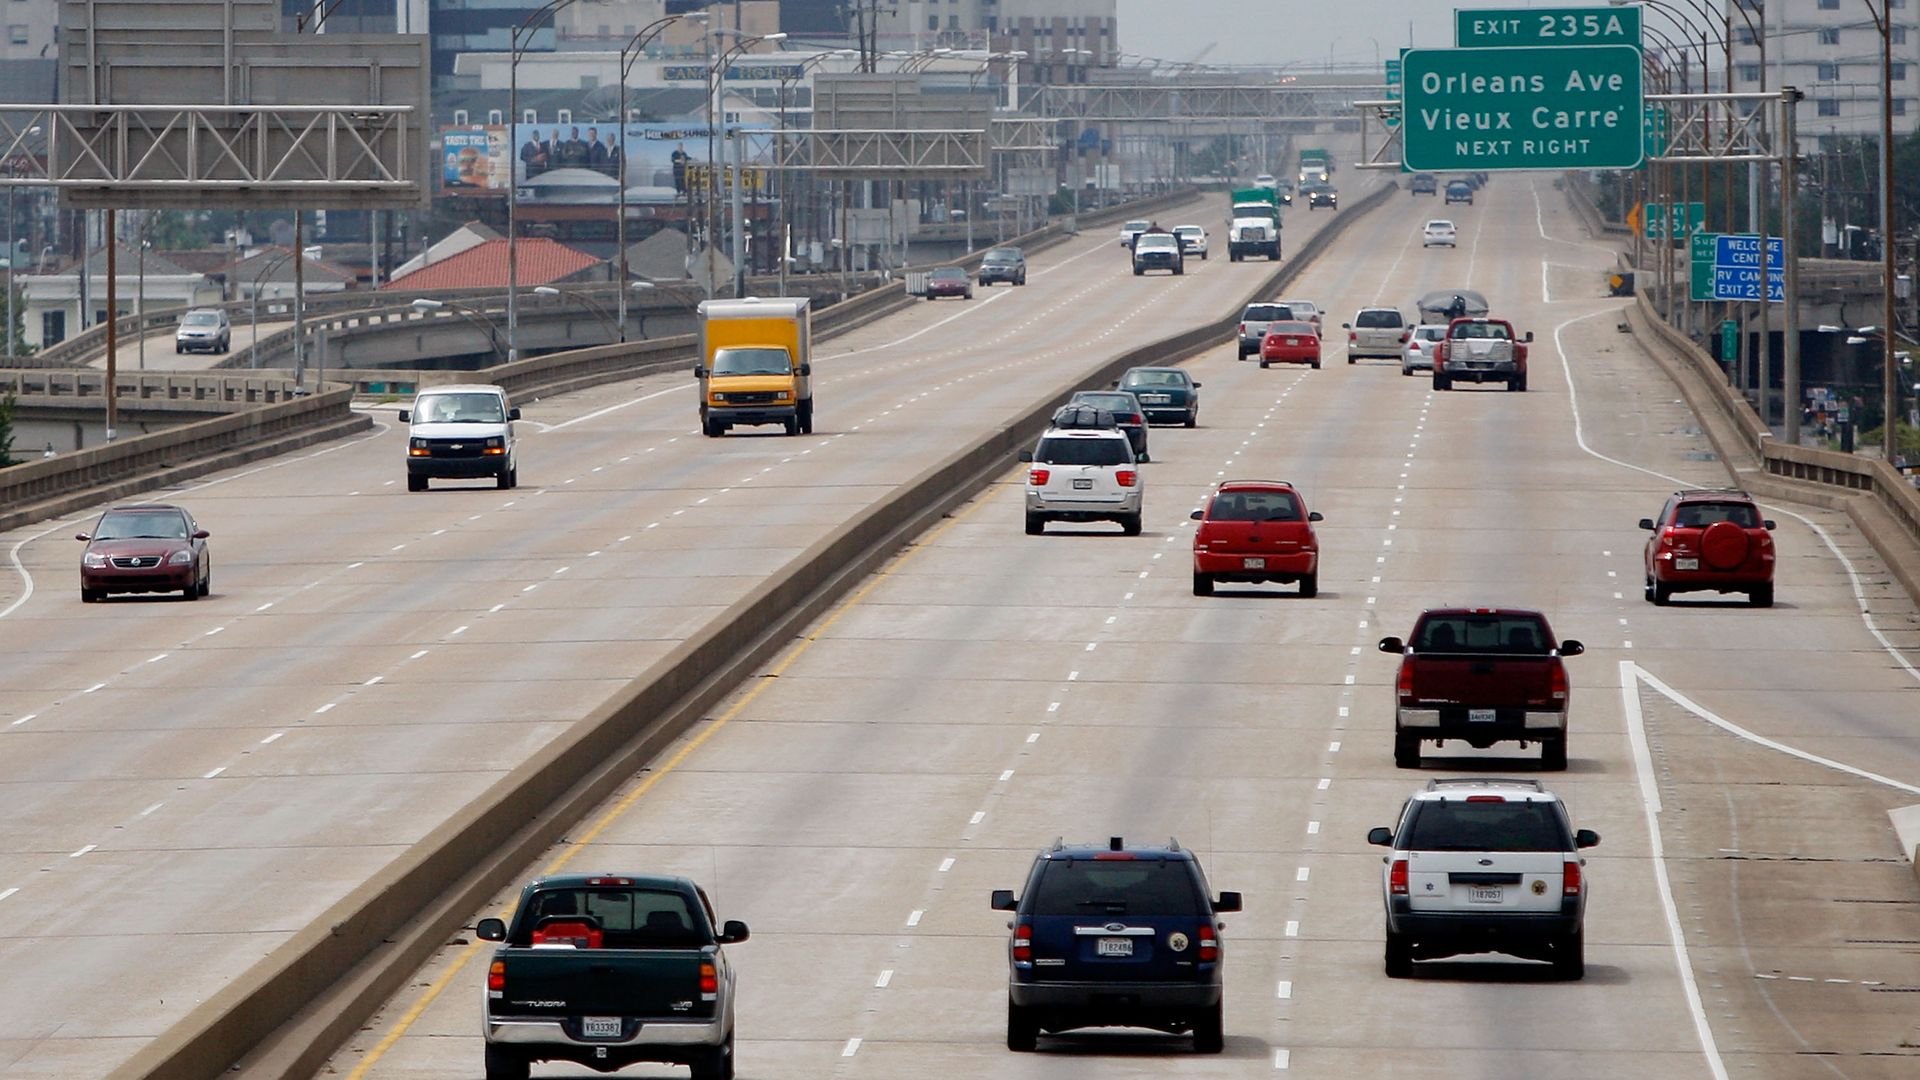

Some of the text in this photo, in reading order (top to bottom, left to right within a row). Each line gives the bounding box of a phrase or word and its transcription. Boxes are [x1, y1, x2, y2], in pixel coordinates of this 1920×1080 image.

[1473, 15, 1624, 37] EXIT 235A
[1421, 71, 1545, 95] Orleans
[1564, 69, 1623, 92] Ave
[1420, 108, 1512, 130] Vieux
[1456, 139, 1590, 156] NEXT RIGHT
[1732, 253, 1774, 264] CENTR
[1717, 271, 1733, 281] RV
[1718, 285, 1743, 295] EXIT
[527, 1000, 567, 1008] TUNDRA
